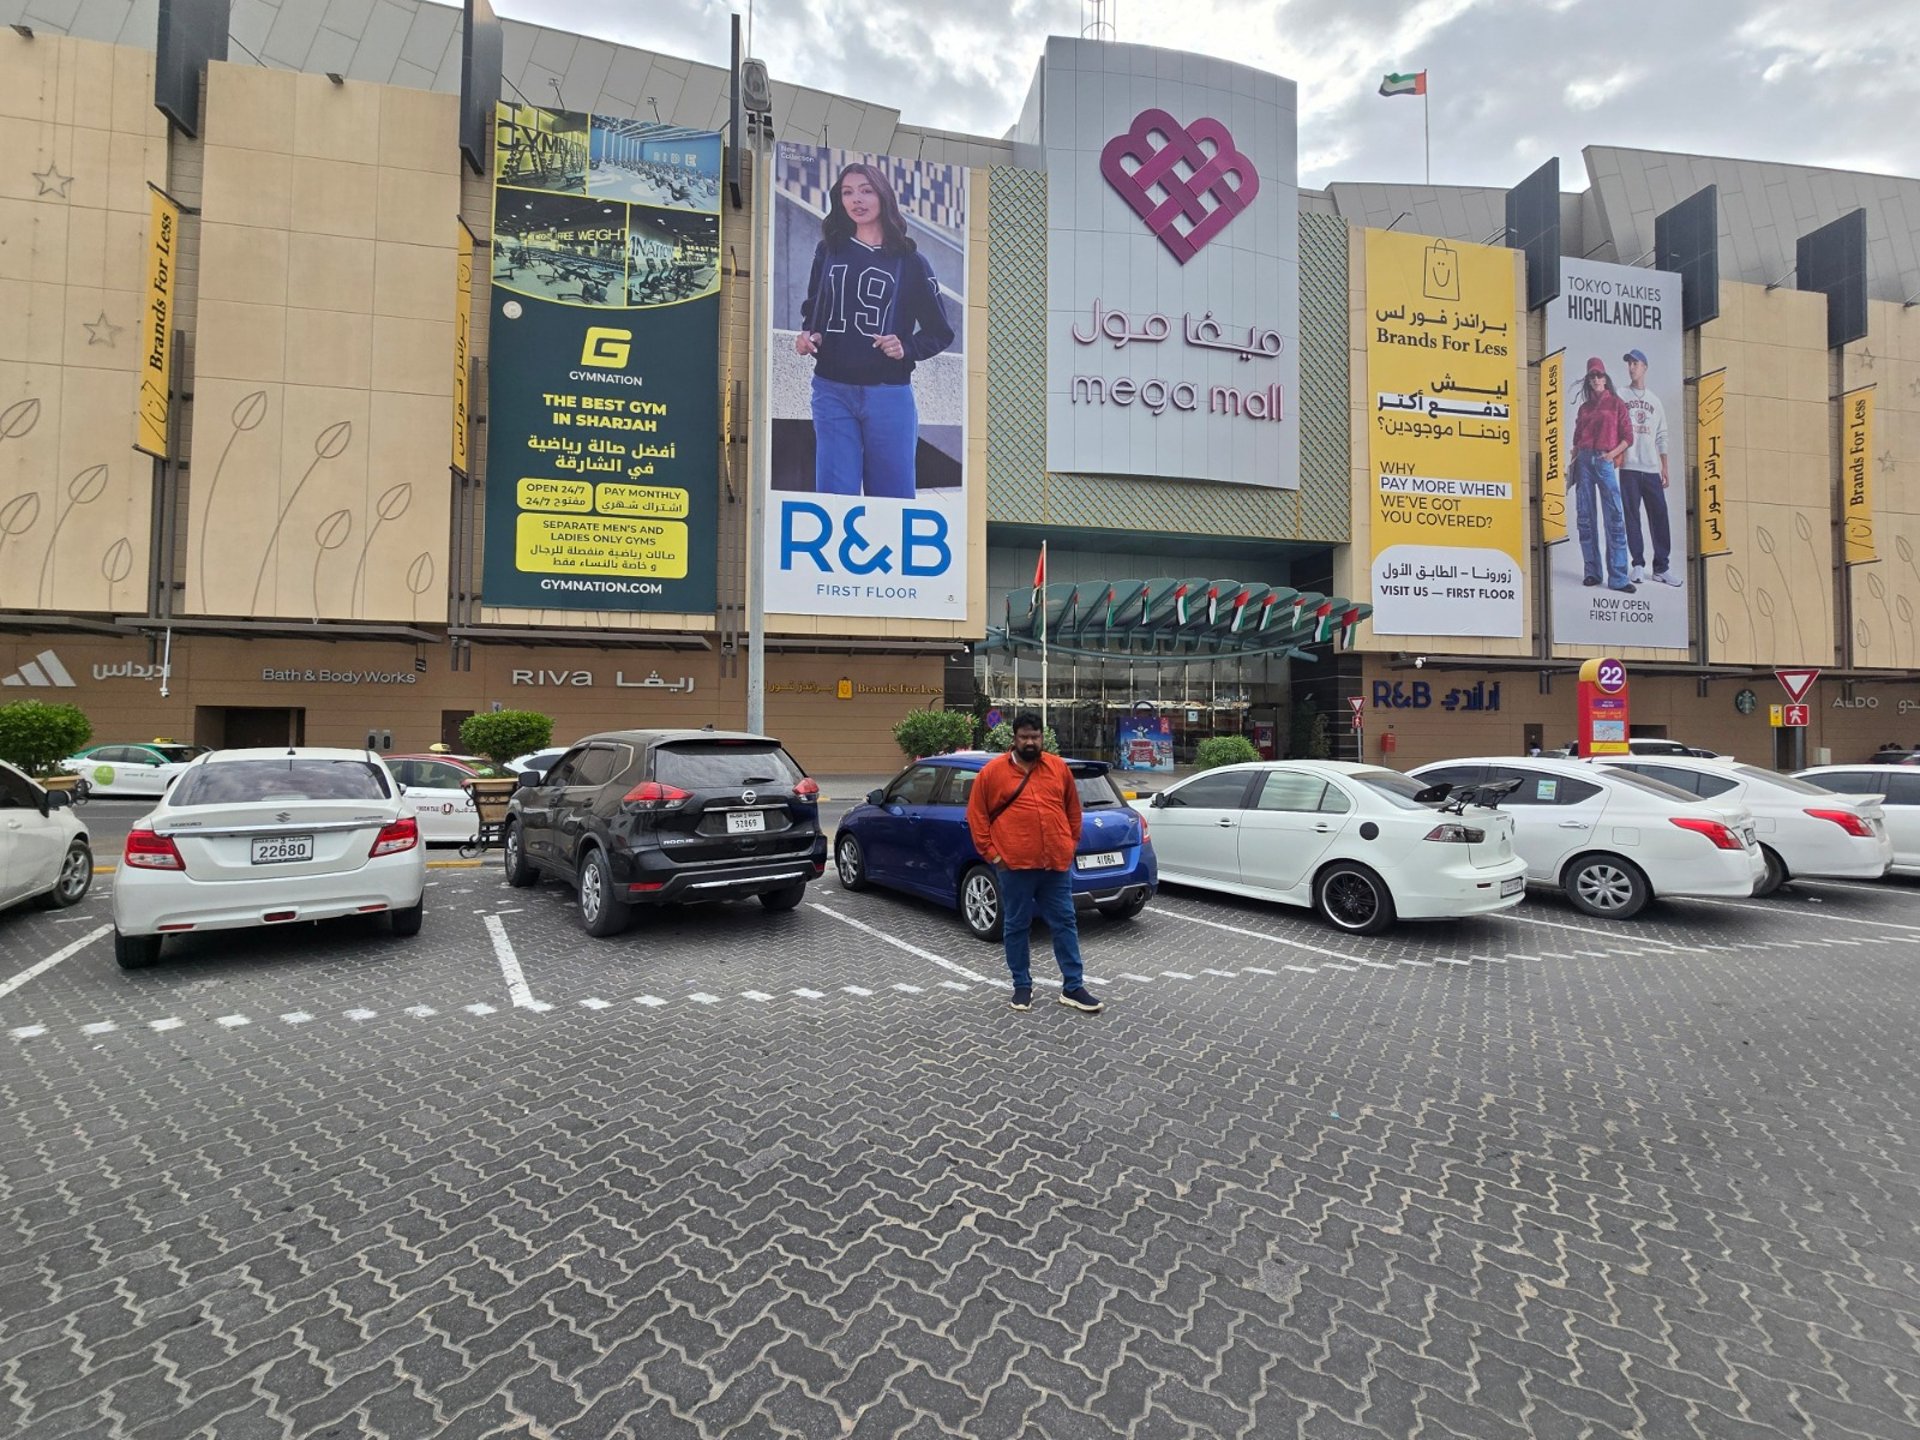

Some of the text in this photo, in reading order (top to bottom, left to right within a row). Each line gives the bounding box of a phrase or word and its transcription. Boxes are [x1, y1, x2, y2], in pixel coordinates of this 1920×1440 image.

[149, 212, 172, 374] Brands For Less
[1567, 276, 1661, 302] TOKYO TALKIES
[827, 264, 895, 337] 19
[1376, 304, 1507, 336] براندز فور لس
[1567, 295, 1662, 331] HIGHLANDER
[1073, 297, 1284, 361] ميغا مول
[1376, 328, 1508, 356] Brands For Less
[569, 371, 643, 387] GYMNATION
[1431, 373, 1508, 400] ليش
[543, 393, 667, 416] THE BEST GYM
[1072, 375, 1284, 422] mega mall
[1378, 389, 1510, 419] تدفع أكتر
[553, 412, 657, 432] IN SHARJAH
[1377, 416, 1510, 445] ونحنا موجودين؟
[1545, 364, 1558, 482] Brands For Less
[527, 434, 676, 459] أفضل صالة رياضية
[1849, 399, 1866, 506] Brands For Less
[555, 455, 654, 480] في الشارقة
[1380, 461, 1416, 475] WHY
[526, 483, 585, 495] OPEN 24/7
[604, 487, 681, 500] PAY MONTHLY
[1380, 476, 1506, 497] PAY MORE WHEN
[1704, 435, 1722, 541] براندز فور لس
[525, 496, 586, 508] مفتوح 24/7
[601, 500, 682, 513] اشتراك شهري
[1380, 494, 1461, 511] WE'VE GOT
[543, 520, 664, 535] SEPARATE MEN'S AND
[1380, 510, 1493, 529] YOU COVERED?
[551, 532, 656, 546] LADIES ONLY GYMS
[780, 500, 952, 577] R&B
[1382, 562, 1412, 580] الأول
[1415, 565, 1458, 581] الطابق
[1472, 566, 1512, 583] زورونا
[540, 579, 662, 595] GYMNATION.COM
[816, 583, 917, 600] FIRST FLOOR
[1380, 585, 1410, 596] VISIT
[1413, 586, 1429, 597] US
[1446, 587, 1475, 599] FIRST
[1479, 588, 1515, 600] FLOOR
[1592, 598, 1650, 611] NOW OPEN
[1589, 610, 1654, 623] FIRST FLOOR
[262, 668, 416, 685] Bath & Body Works
[1600, 666, 1623, 685] 22
[857, 683, 943, 695] Brands For Less
[1373, 680, 1432, 709] R&B
[1832, 697, 1879, 708] ALDO
[259, 843, 306, 859] 22680
